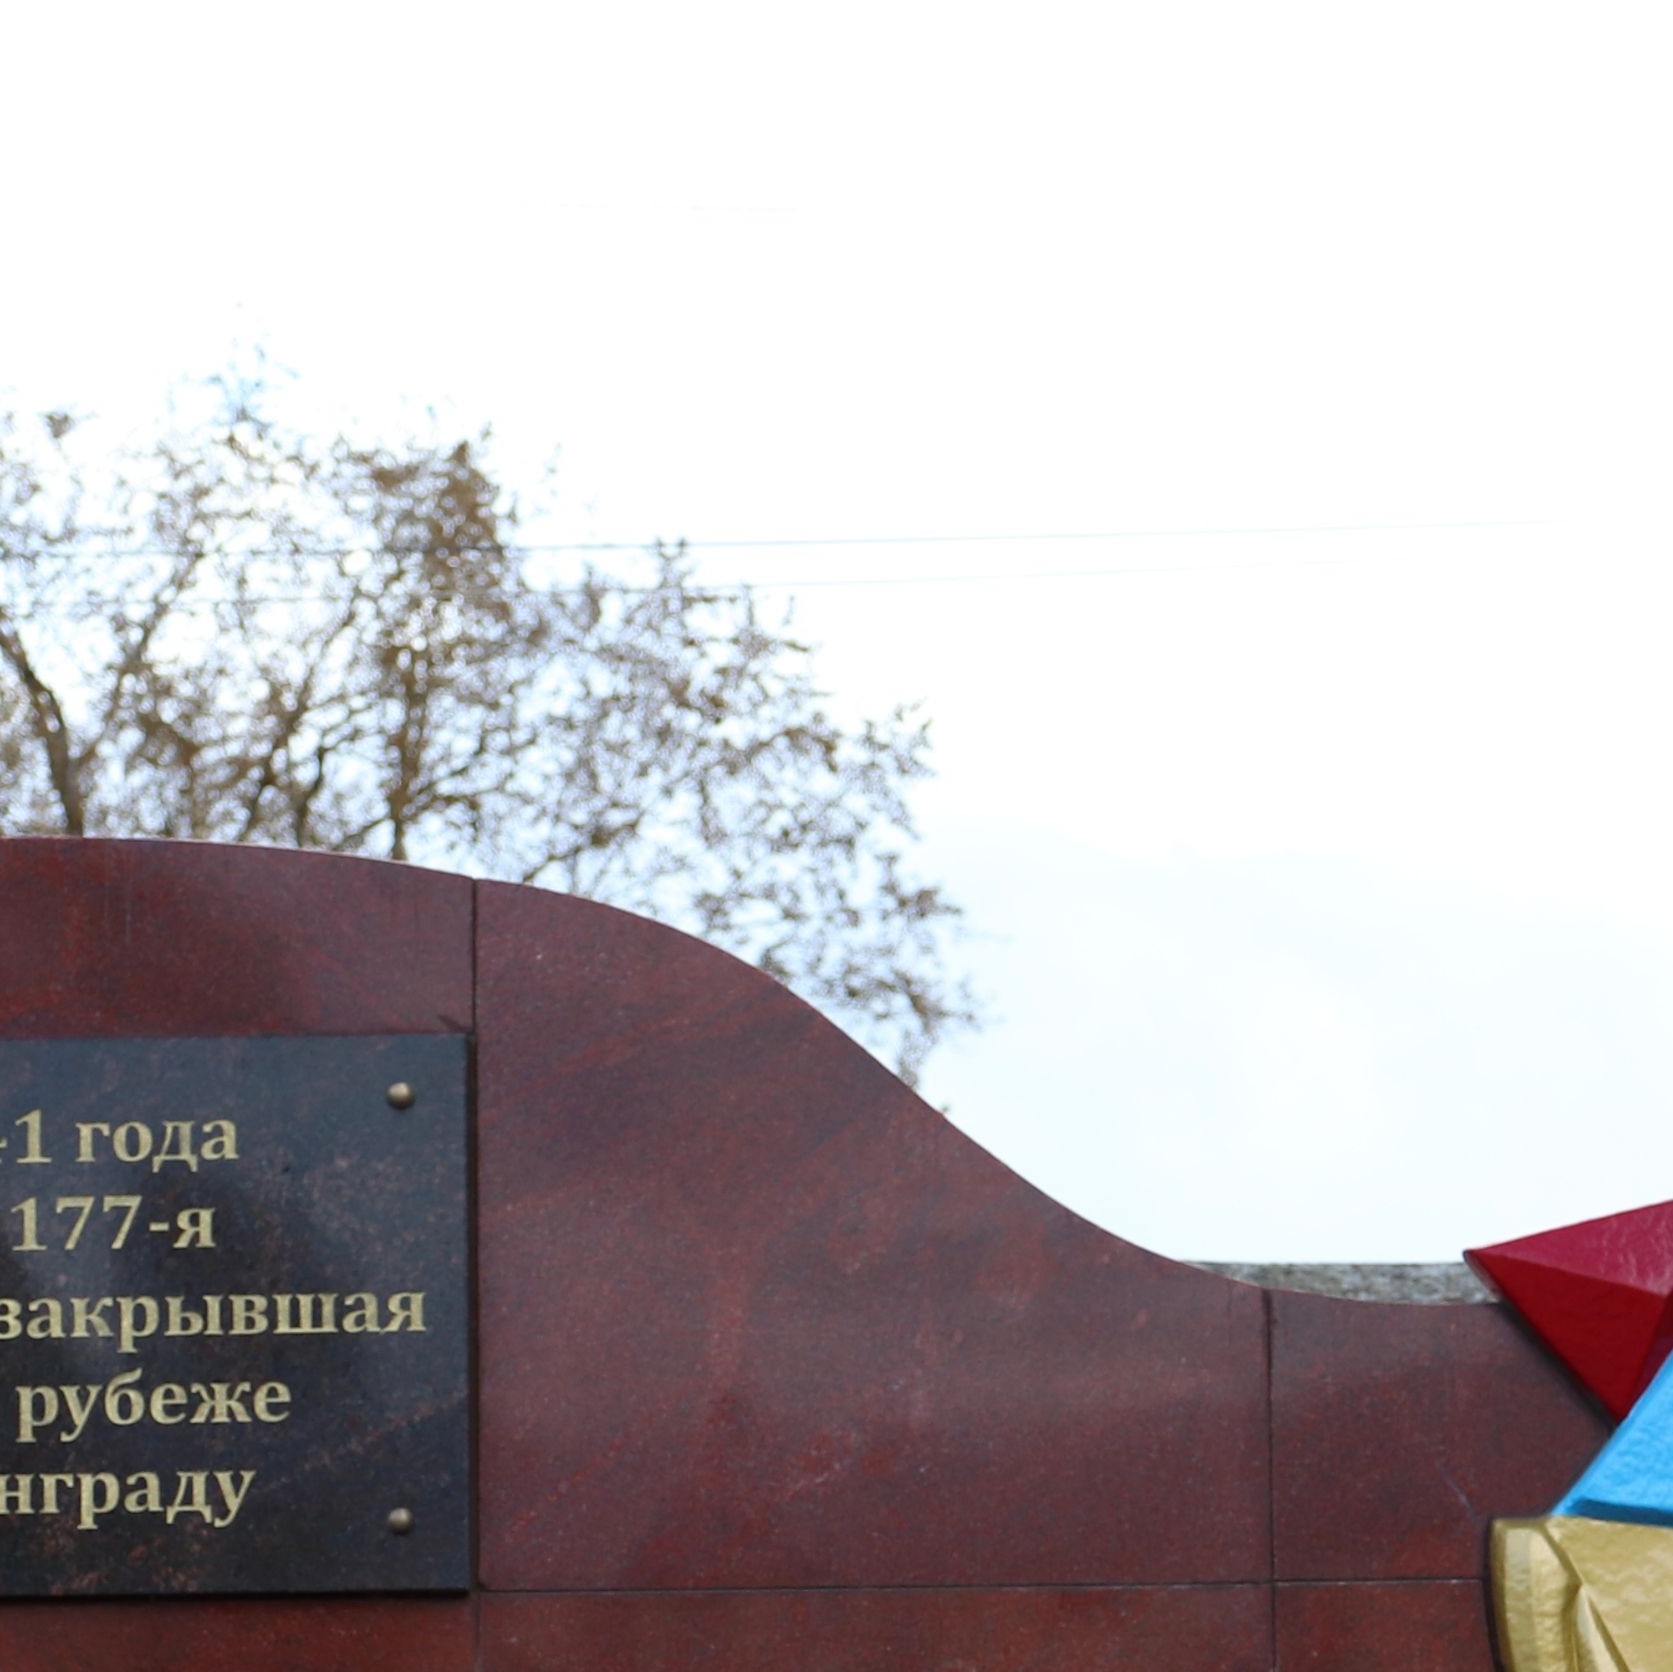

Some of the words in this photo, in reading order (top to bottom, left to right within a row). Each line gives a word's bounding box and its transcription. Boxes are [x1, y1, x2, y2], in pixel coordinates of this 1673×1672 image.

[76, 1118, 240, 1174] года
[11, 1193, 216, 1253] 177-я
[15, 1367, 292, 1444] рубеже
